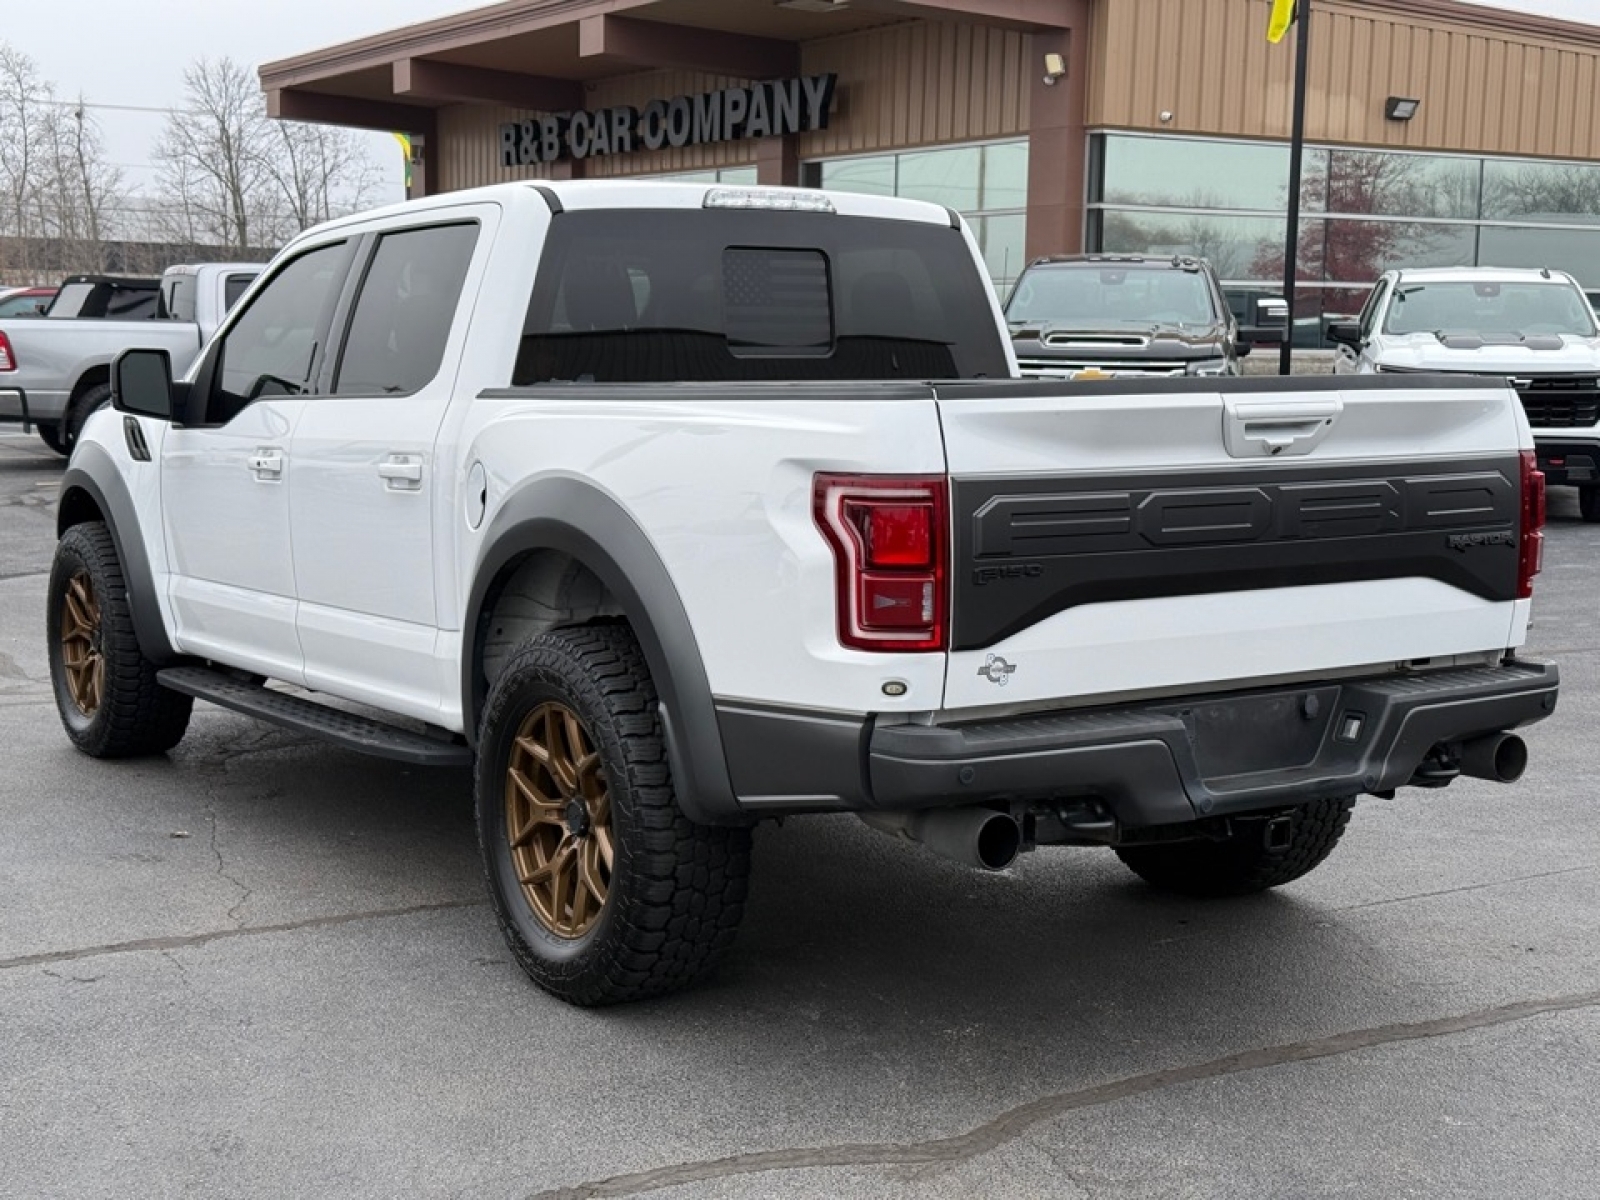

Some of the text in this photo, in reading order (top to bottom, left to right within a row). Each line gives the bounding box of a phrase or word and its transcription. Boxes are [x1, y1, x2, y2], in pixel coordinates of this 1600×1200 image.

[500, 73, 836, 167] R&B CAR COMPANY
[972, 472, 1513, 559] FORD
[1446, 530, 1514, 552] RAPTOR
